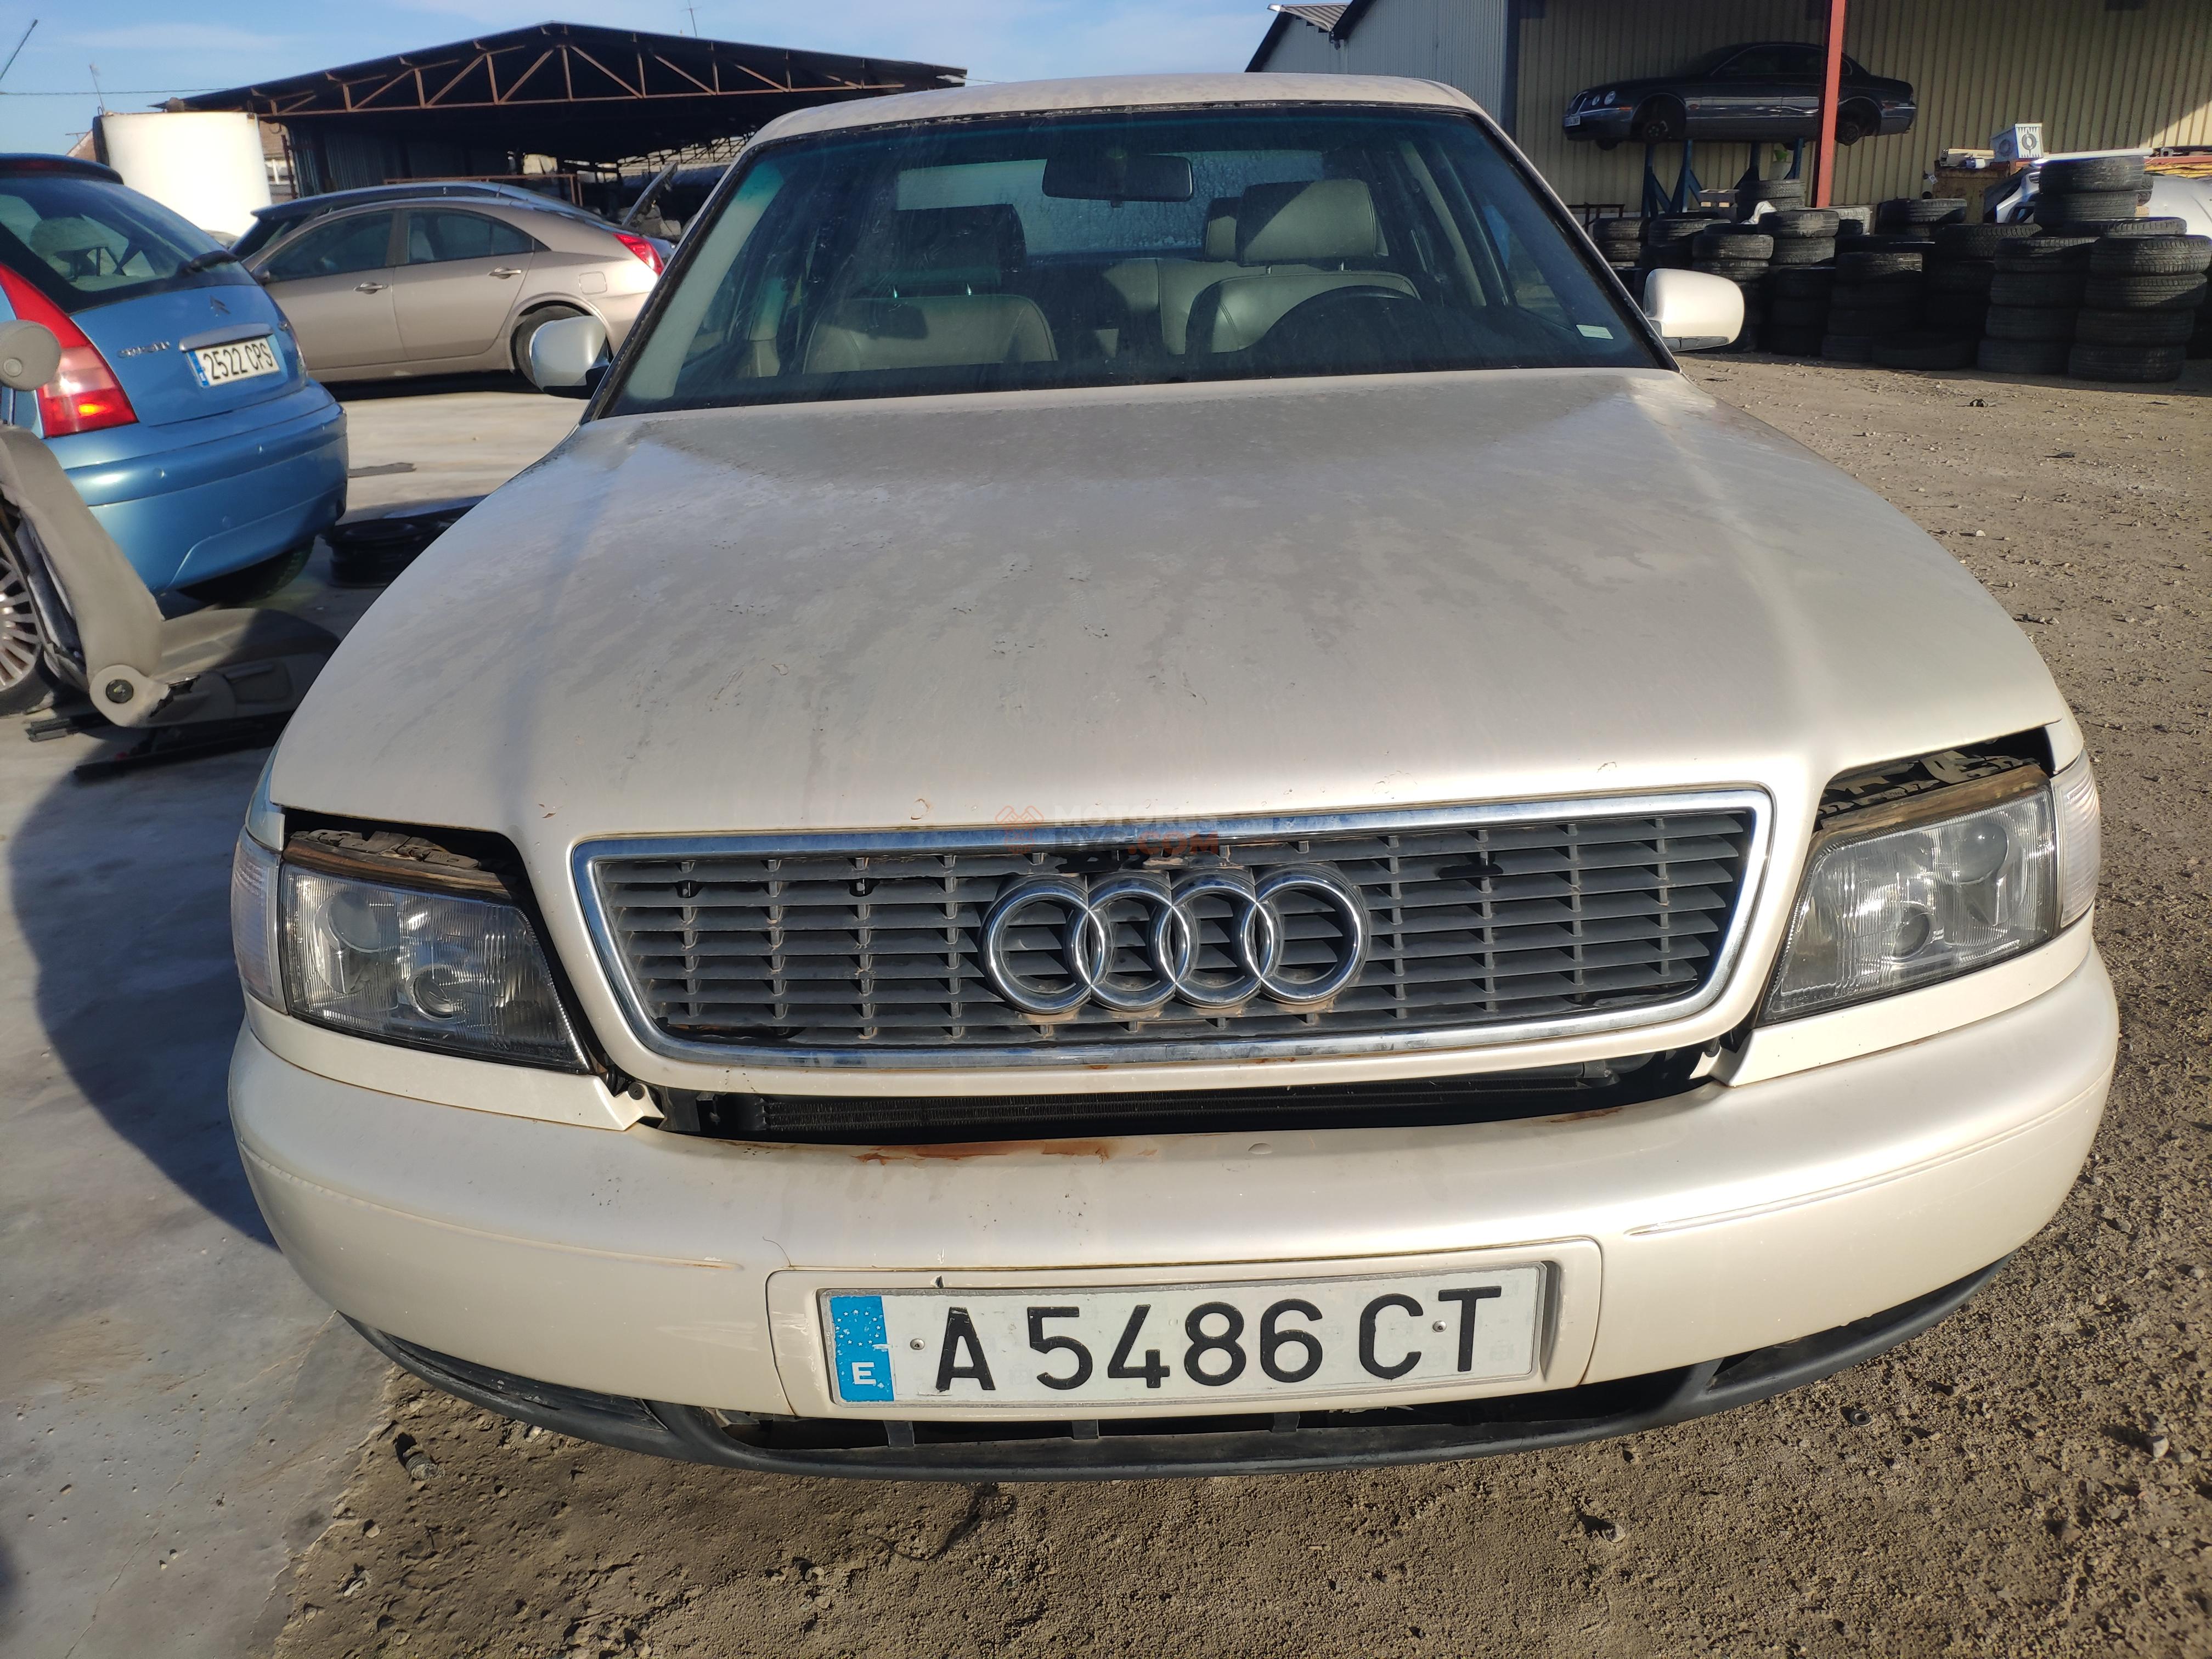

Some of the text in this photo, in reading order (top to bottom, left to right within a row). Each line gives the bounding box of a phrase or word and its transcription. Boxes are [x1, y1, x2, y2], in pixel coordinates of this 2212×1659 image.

[204, 348, 247, 380] 2522
[245, 342, 273, 370] CPS
[935, 1286, 1502, 1391] A 5486 CT
[851, 1362, 876, 1385] E
